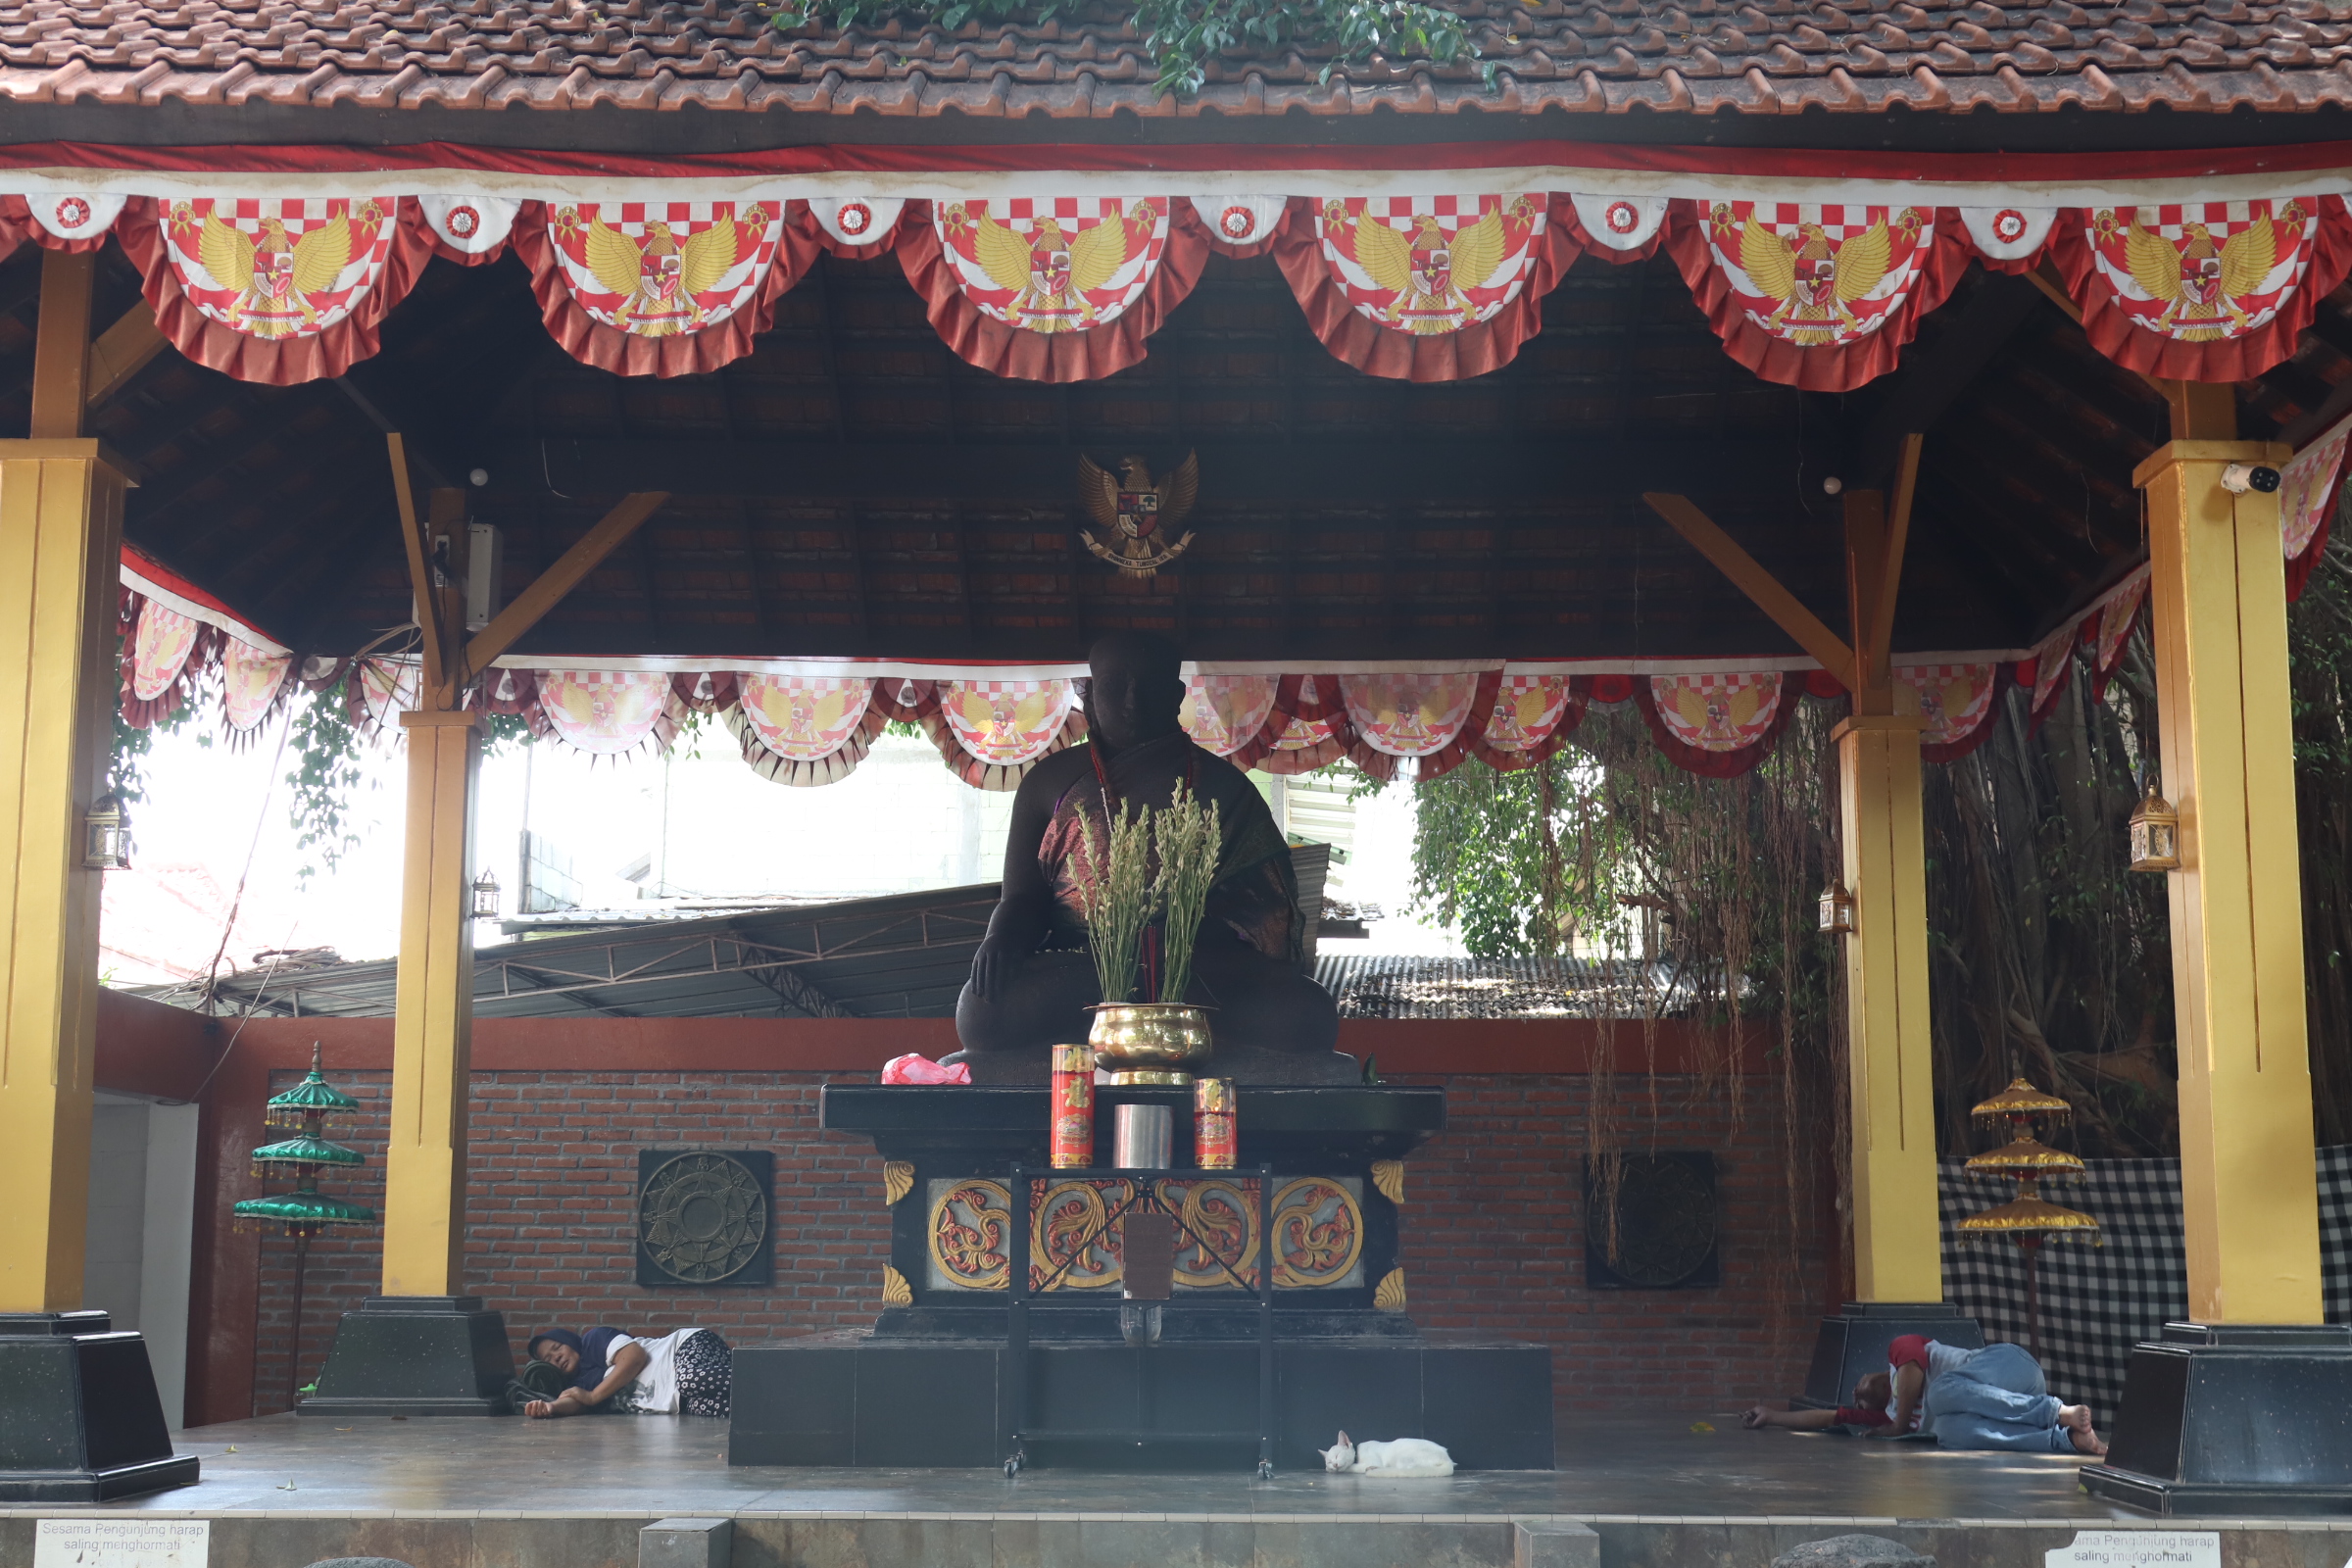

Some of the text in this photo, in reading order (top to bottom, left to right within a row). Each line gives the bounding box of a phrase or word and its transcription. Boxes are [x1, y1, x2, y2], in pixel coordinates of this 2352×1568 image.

[42, 1522, 204, 1538] Sesama Pengunjung harap
[64, 1538, 181, 1552] saling menghormati
[2104, 1535, 2176, 1548] Pengunjung
[2180, 1535, 2215, 1548] harap
[2074, 1549, 2192, 1564] saling menghormati
